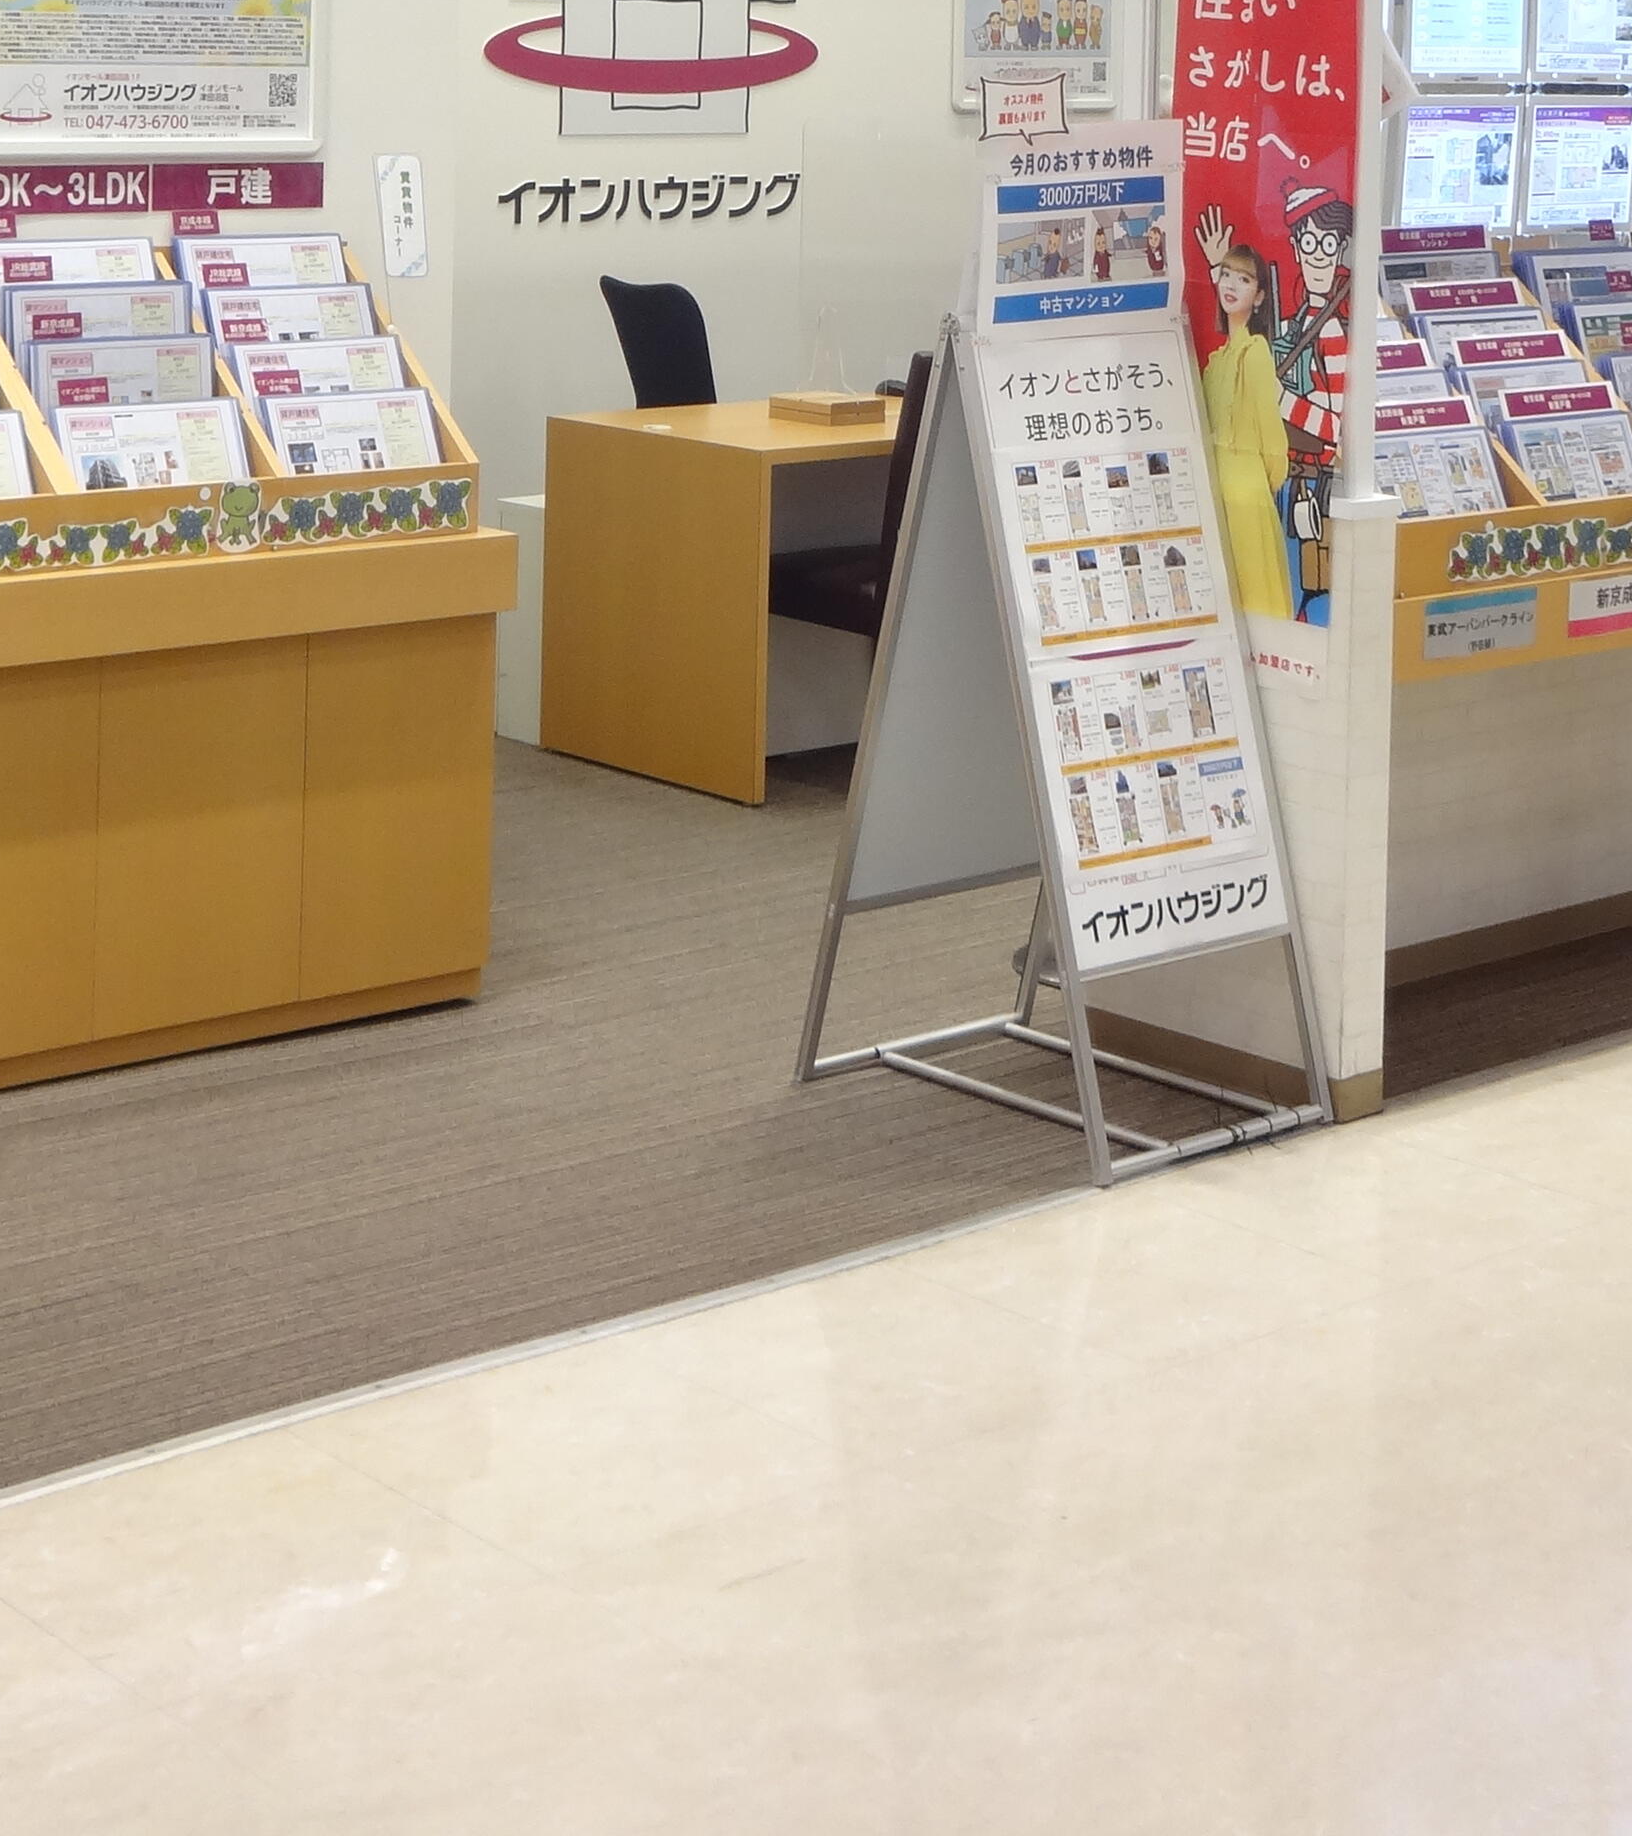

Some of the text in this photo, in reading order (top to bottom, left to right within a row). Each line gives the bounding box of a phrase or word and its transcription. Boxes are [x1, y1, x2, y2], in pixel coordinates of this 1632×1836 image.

[1189, 45, 1345, 102] さがしは、
[64, 83, 197, 102] イオンハウジング
[1185, 111, 1310, 170] 当店へ。
[1010, 145, 1154, 177] 今月のおすすめ物件
[207, 169, 272, 204] 戸建
[498, 172, 800, 225] イオンハウジング
[1038, 181, 1124, 206] 3000万円以下
[1039, 293, 1124, 315] 中古マンション
[999, 363, 1173, 399] イオンとさがそう、
[1025, 406, 1163, 442] 理想のおうち。
[1428, 611, 1534, 637] 東武アーバンパークライン
[1082, 873, 1268, 944] イオンハウジング
